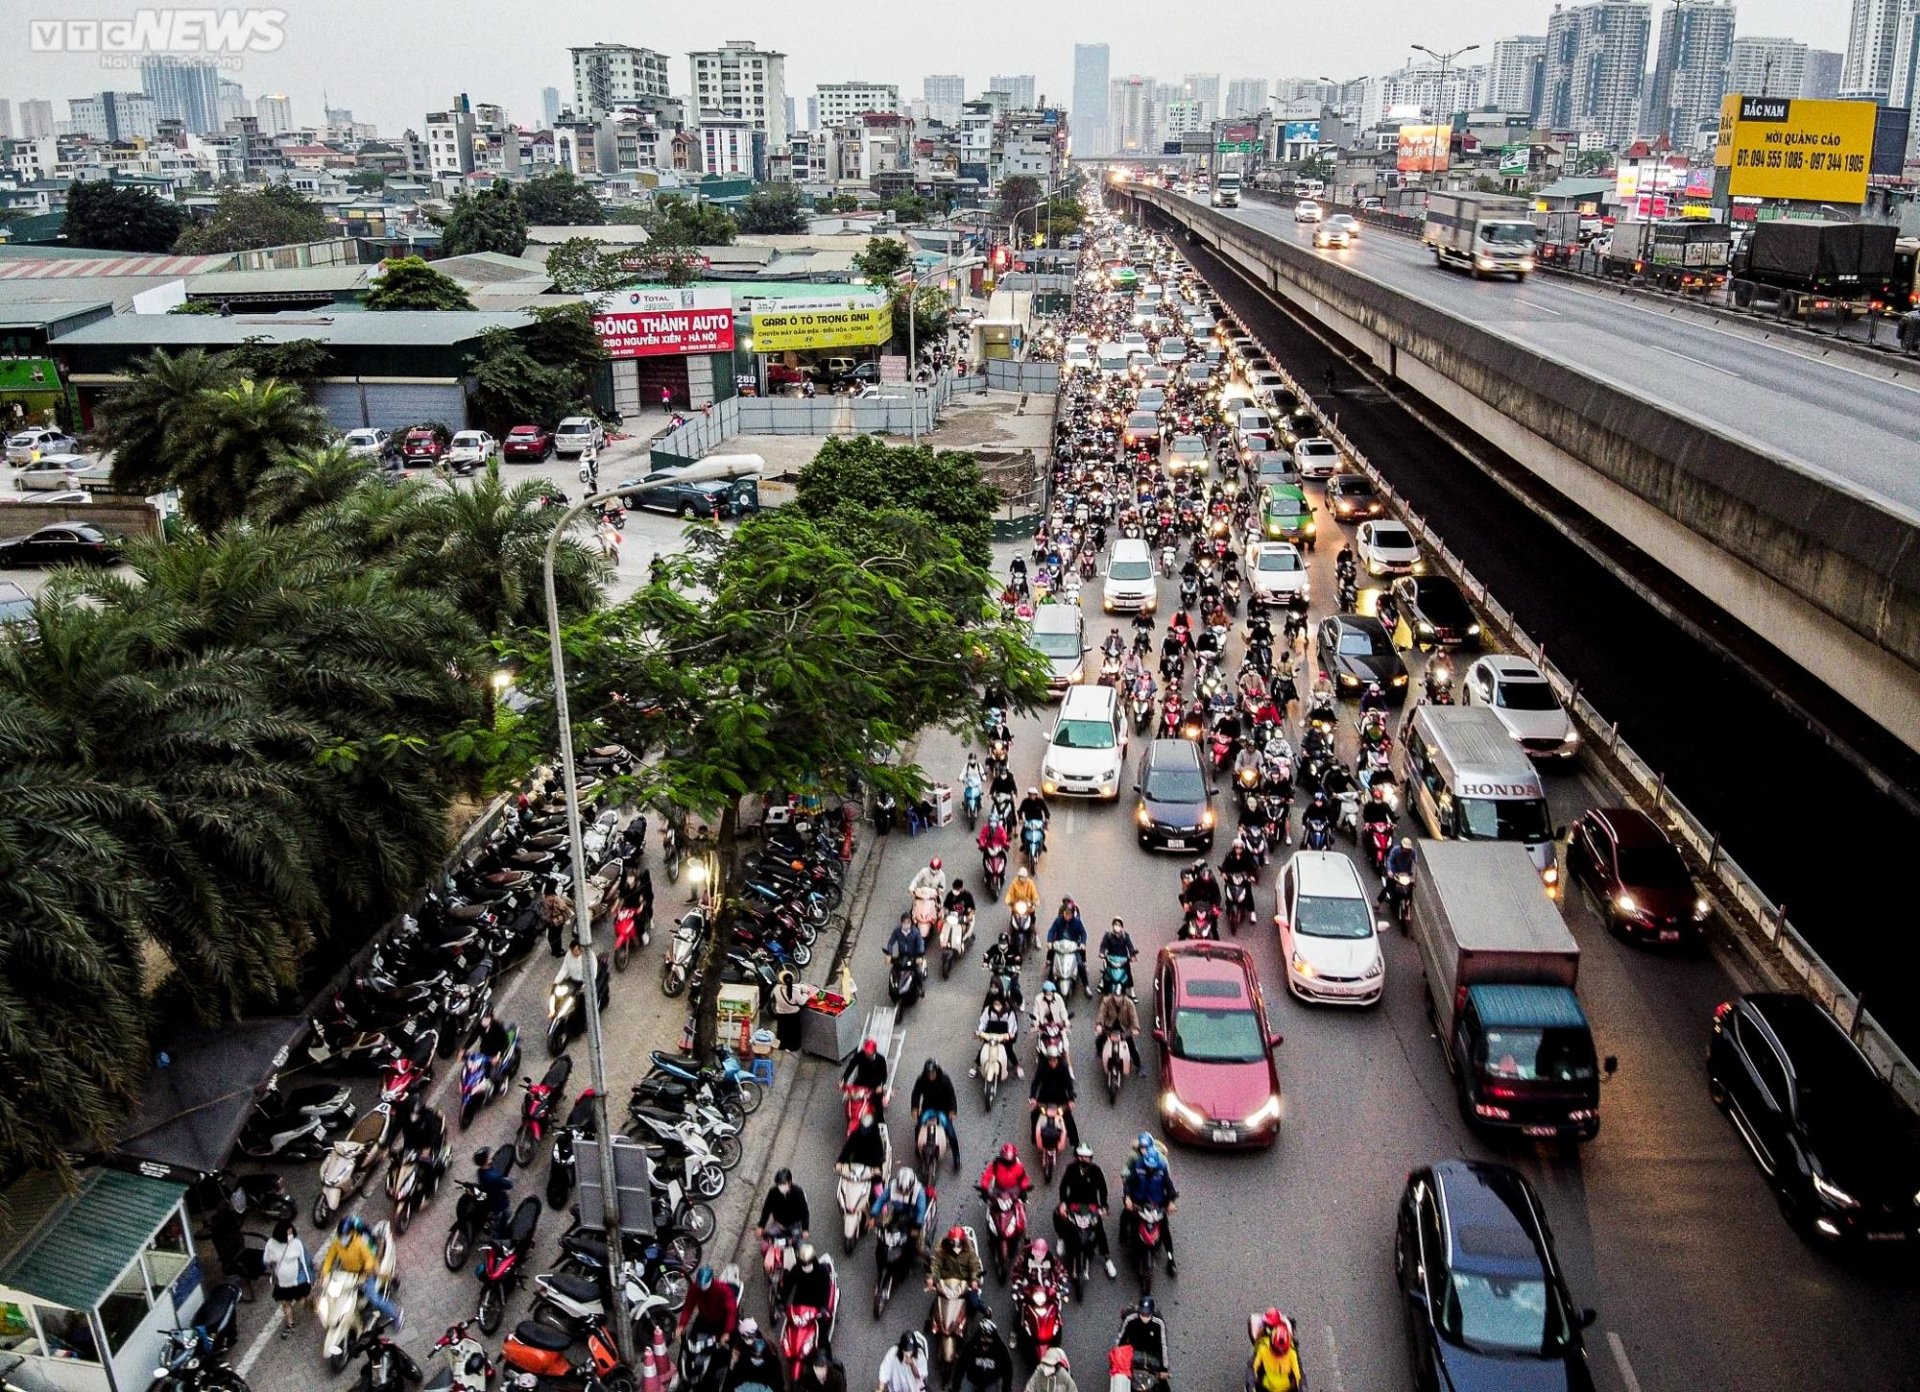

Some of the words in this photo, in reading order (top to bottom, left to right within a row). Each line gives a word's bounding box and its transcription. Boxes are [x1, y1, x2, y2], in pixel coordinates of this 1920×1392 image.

[1743, 99, 1763, 116] BẮC
[1763, 104, 1785, 117] NAM
[1718, 132, 1732, 146] NAM
[1765, 130, 1782, 143] MỜI
[1785, 130, 1818, 145] QUẢNG
[1821, 132, 1841, 146] CÁO
[1750, 149, 1765, 167] 094
[1766, 150, 1782, 168] 555
[1784, 151, 1803, 169] 1085
[1810, 152, 1826, 170] 097
[1827, 153, 1842, 171] 344
[1844, 154, 1864, 172] 1905
[593, 316, 638, 335] ĐÔNG
[641, 314, 689, 333] THÀNH
[692, 314, 729, 331] AUTO
[762, 318, 787, 327] GARA
[790, 315, 798, 325] Ô
[801, 315, 813, 325] TÔ
[816, 314, 848, 326] TRỌNG
[850, 313, 870, 322] ANH
[624, 333, 660, 346] NGUYỄN
[688, 331, 701, 342] HÀ
[702, 331, 717, 343] NỘI
[736, 375, 756, 384] 280
[1463, 783, 1538, 796] HONDA
